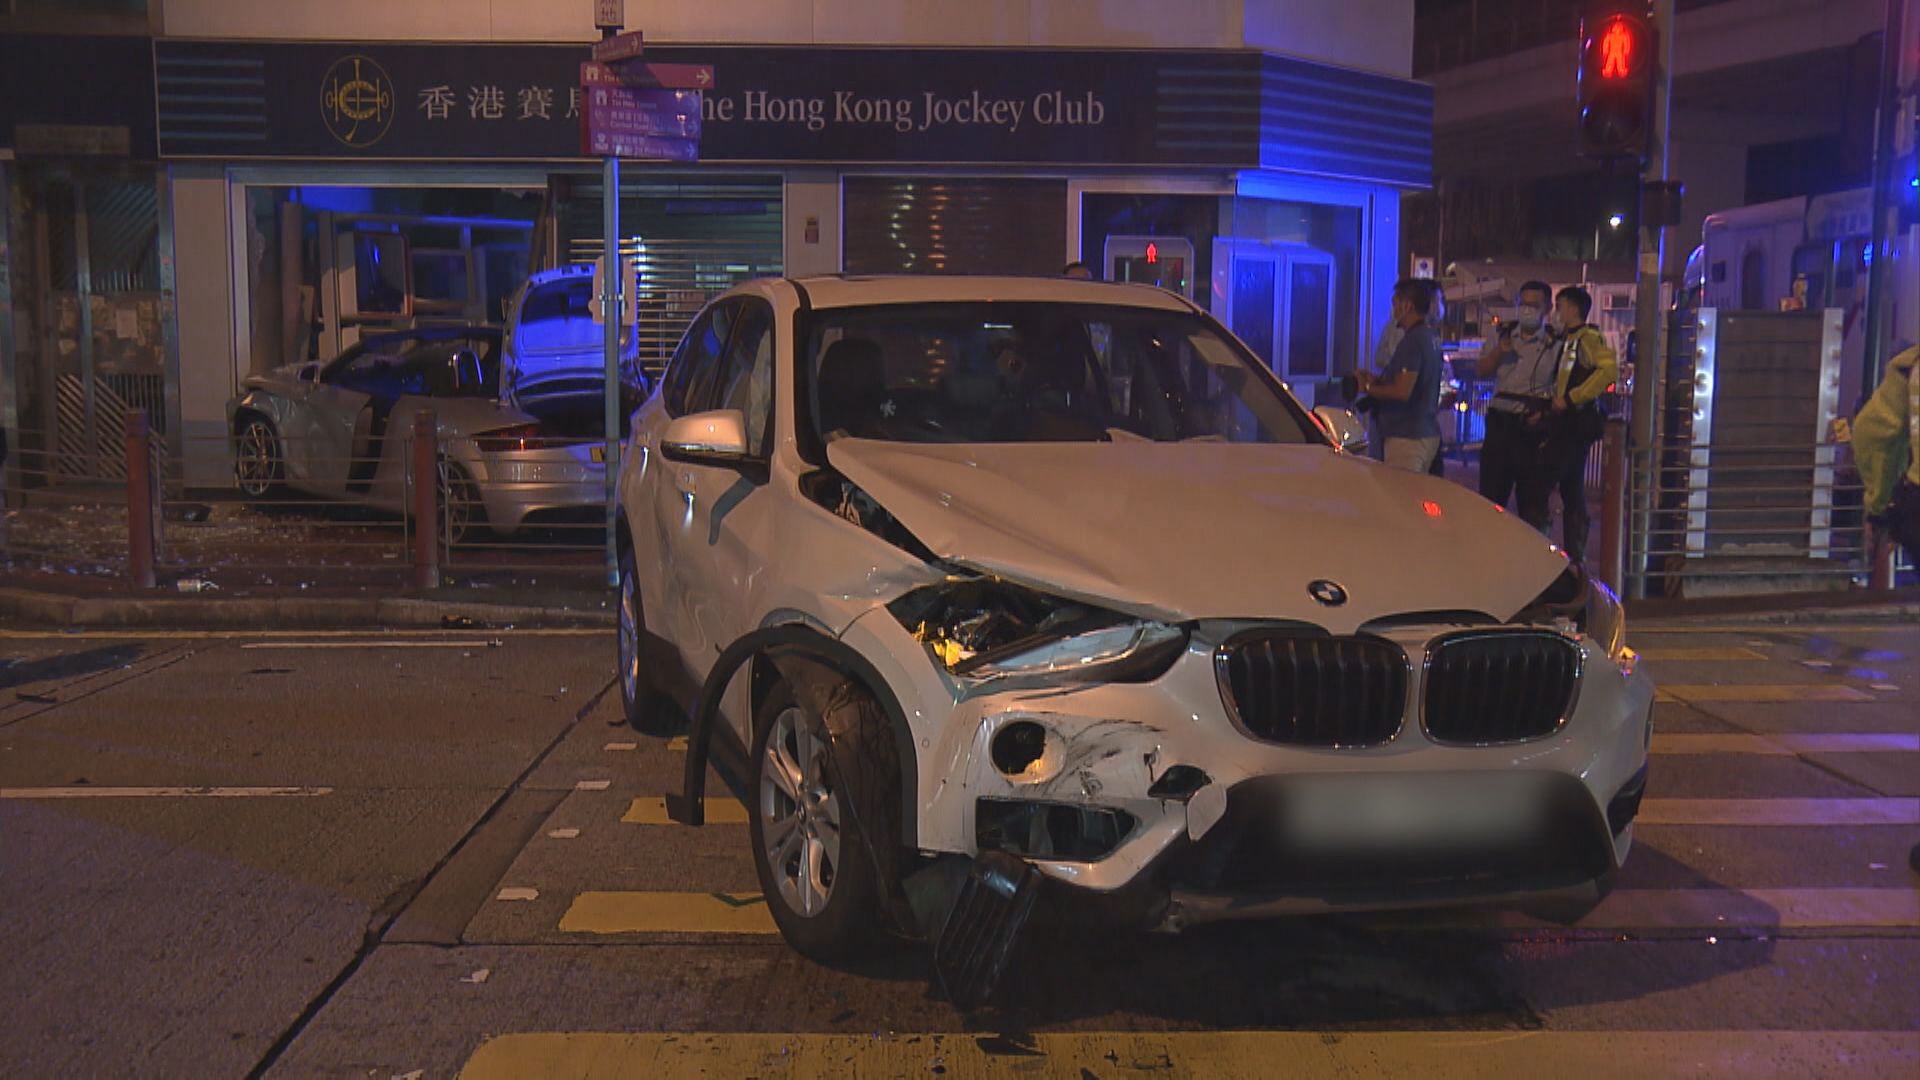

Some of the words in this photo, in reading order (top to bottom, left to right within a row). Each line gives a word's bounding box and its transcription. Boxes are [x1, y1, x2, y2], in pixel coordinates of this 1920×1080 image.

[699, 90, 734, 122] he
[744, 91, 825, 131] Hong
[834, 91, 914, 131] Kong
[919, 91, 1025, 132] Jockey
[1032, 90, 1105, 124] Club
